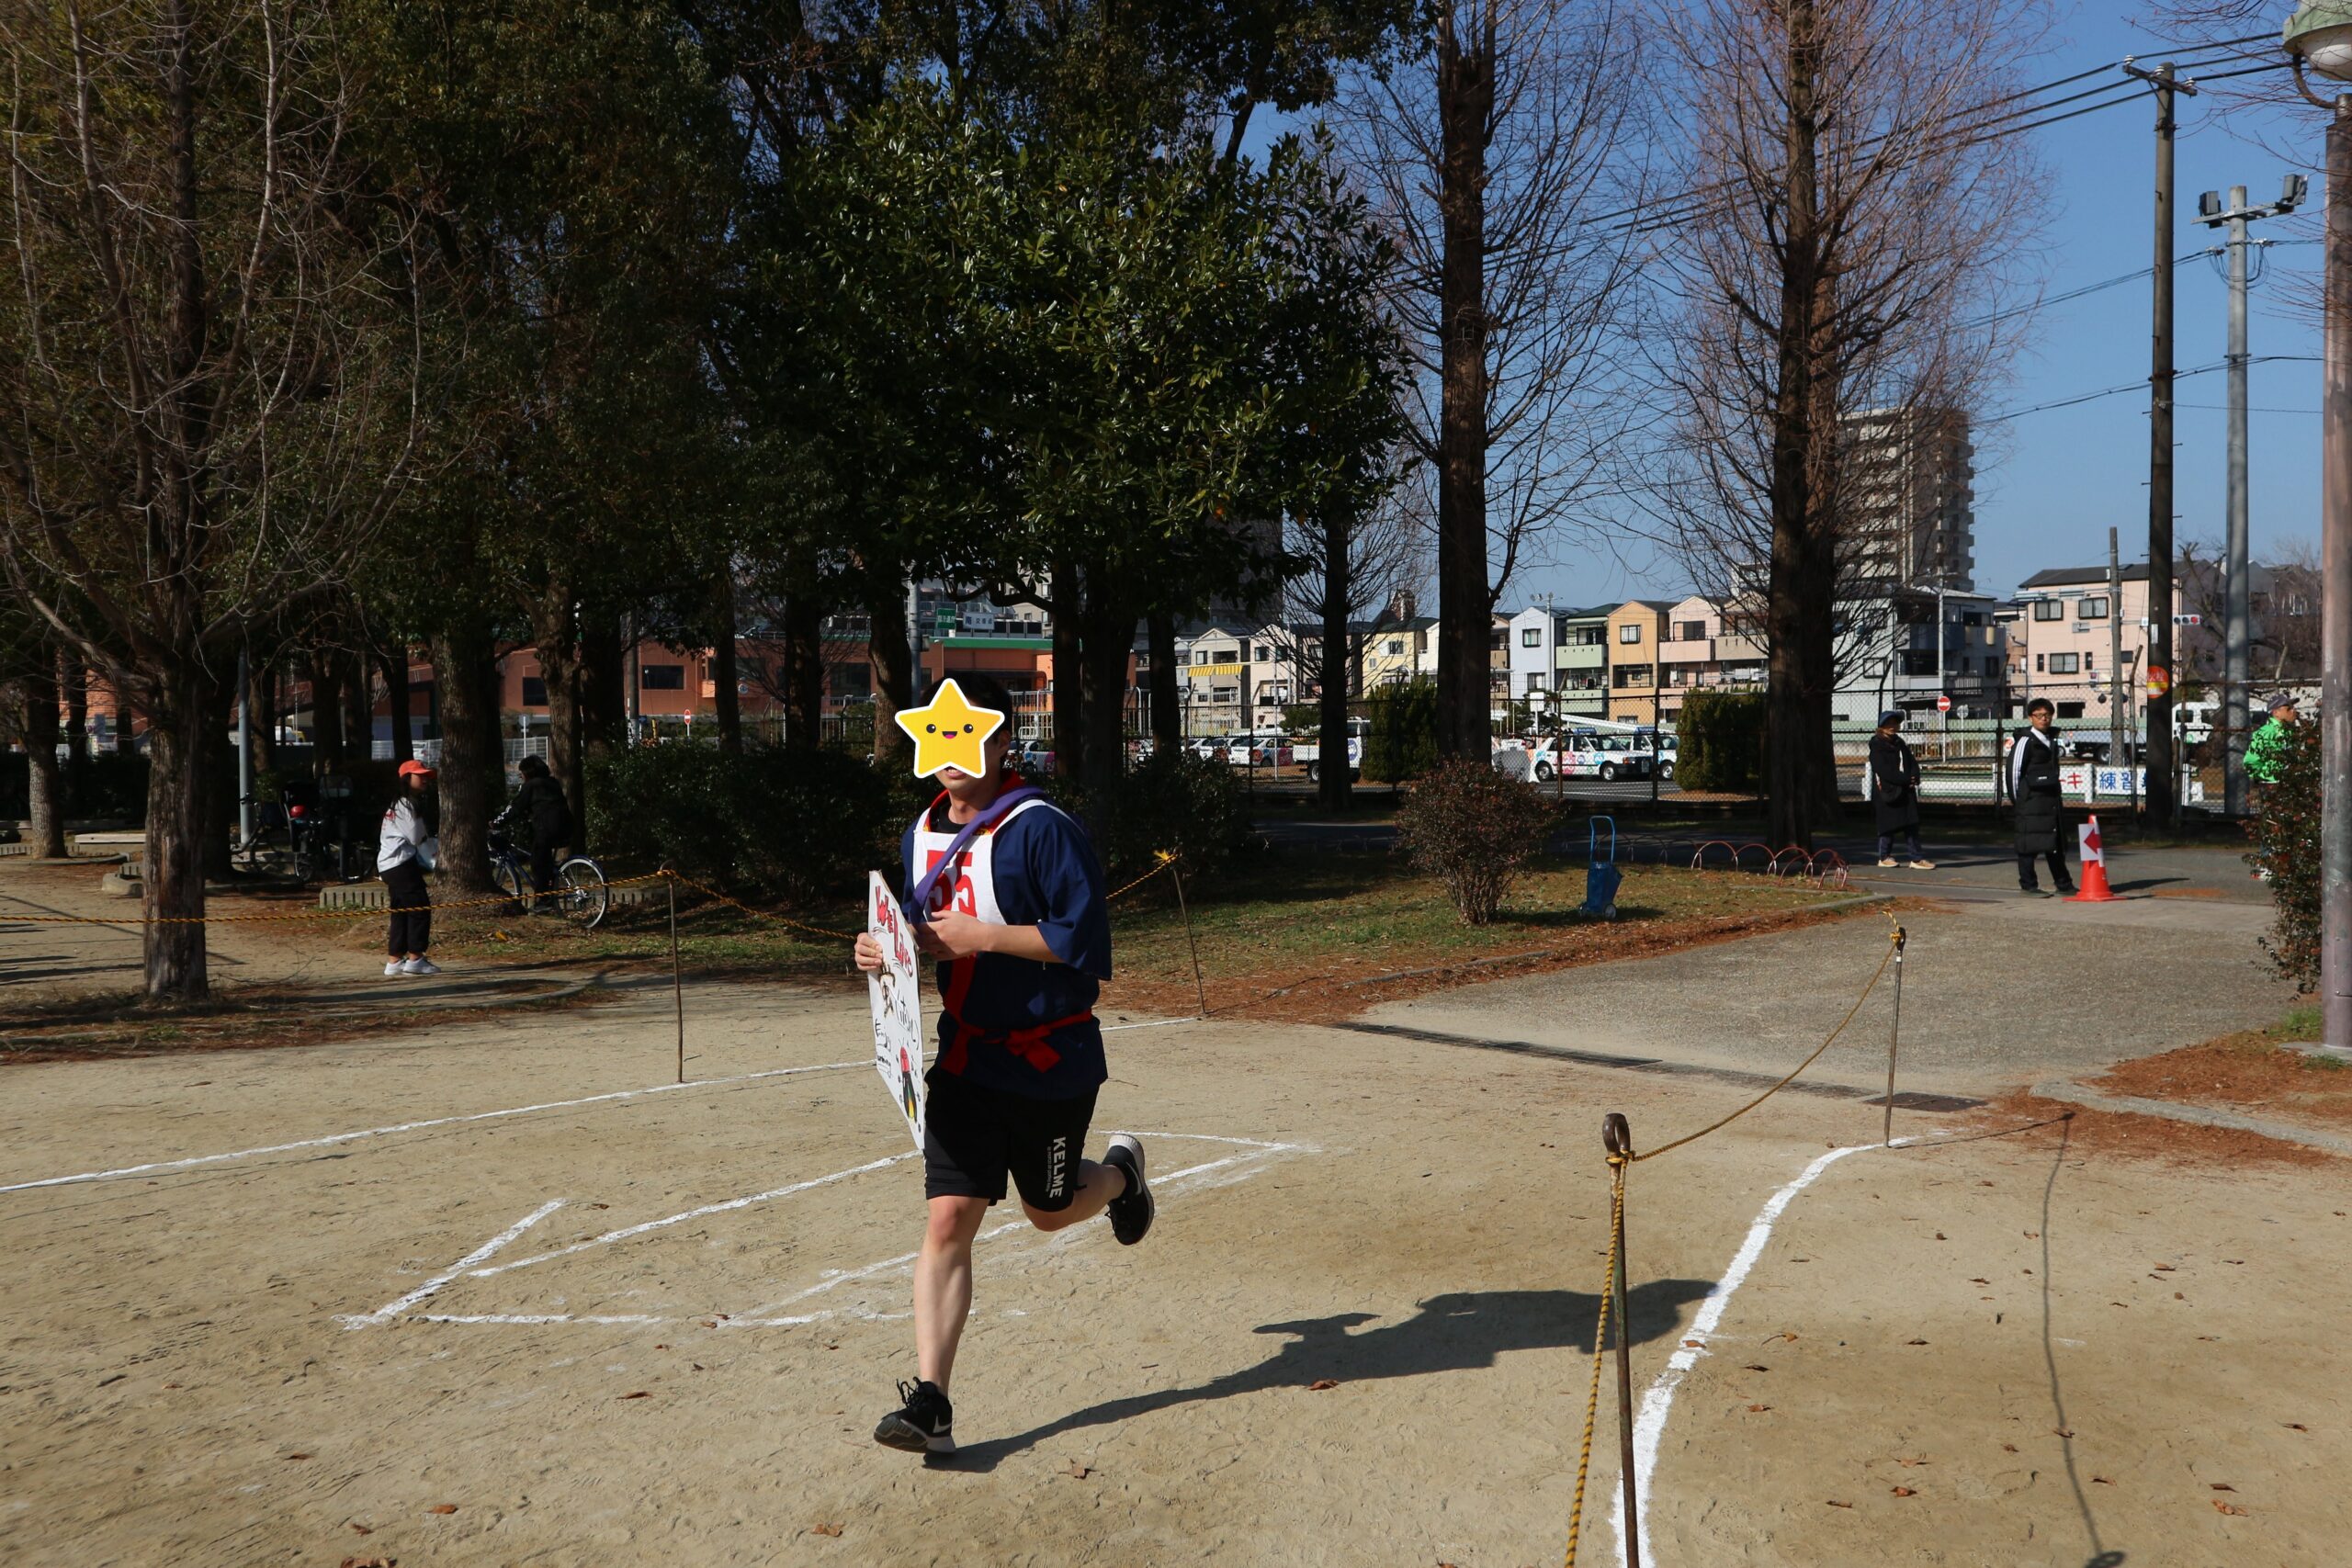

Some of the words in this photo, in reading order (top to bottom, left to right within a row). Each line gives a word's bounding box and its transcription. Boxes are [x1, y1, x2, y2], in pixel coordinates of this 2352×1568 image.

[2099, 771, 2147, 791] 練習
[926, 850, 978, 918] 55
[1049, 1136, 1066, 1199] KELME
